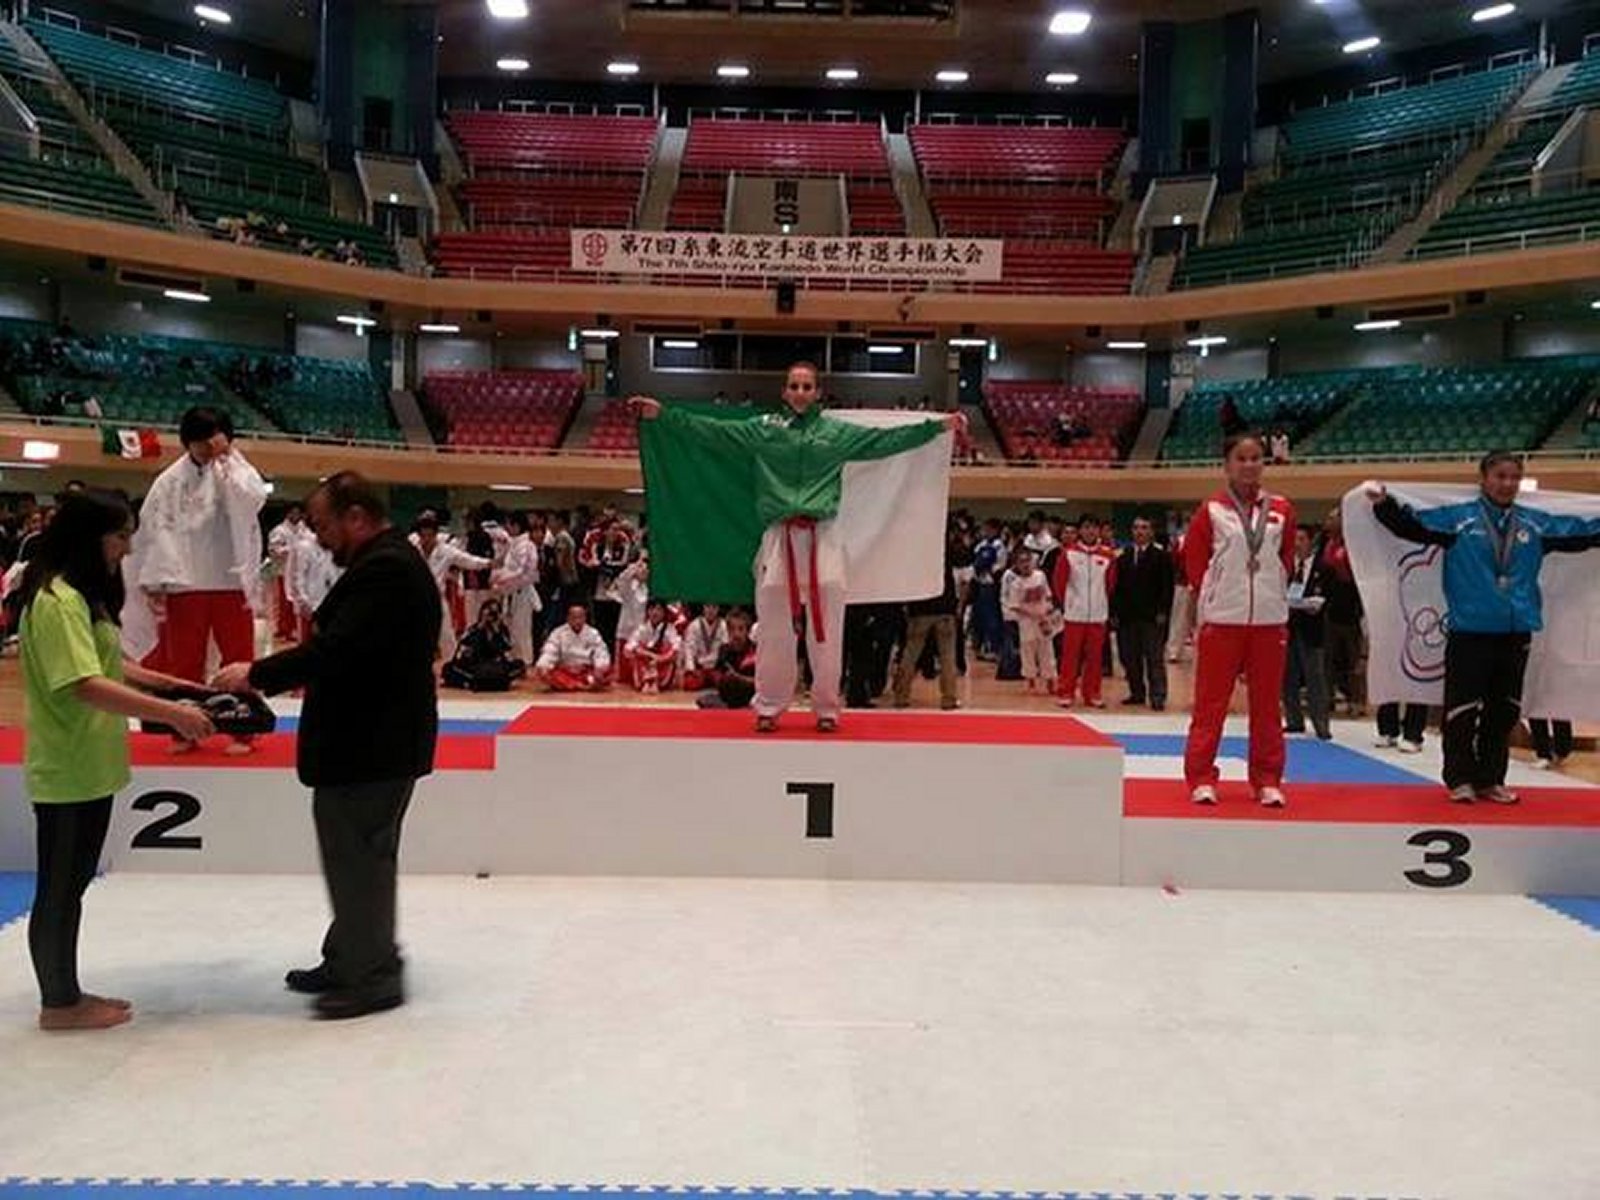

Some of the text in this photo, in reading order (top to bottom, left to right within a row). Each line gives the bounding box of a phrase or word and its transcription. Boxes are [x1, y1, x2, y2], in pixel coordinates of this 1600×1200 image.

[638, 259, 662, 269] The
[668, 259, 689, 269] 7th
[825, 263, 865, 274] World
[868, 265, 967, 278] Championship
[131, 790, 202, 849] 2
[786, 782, 835, 838] 1
[1403, 829, 1472, 888] 3
